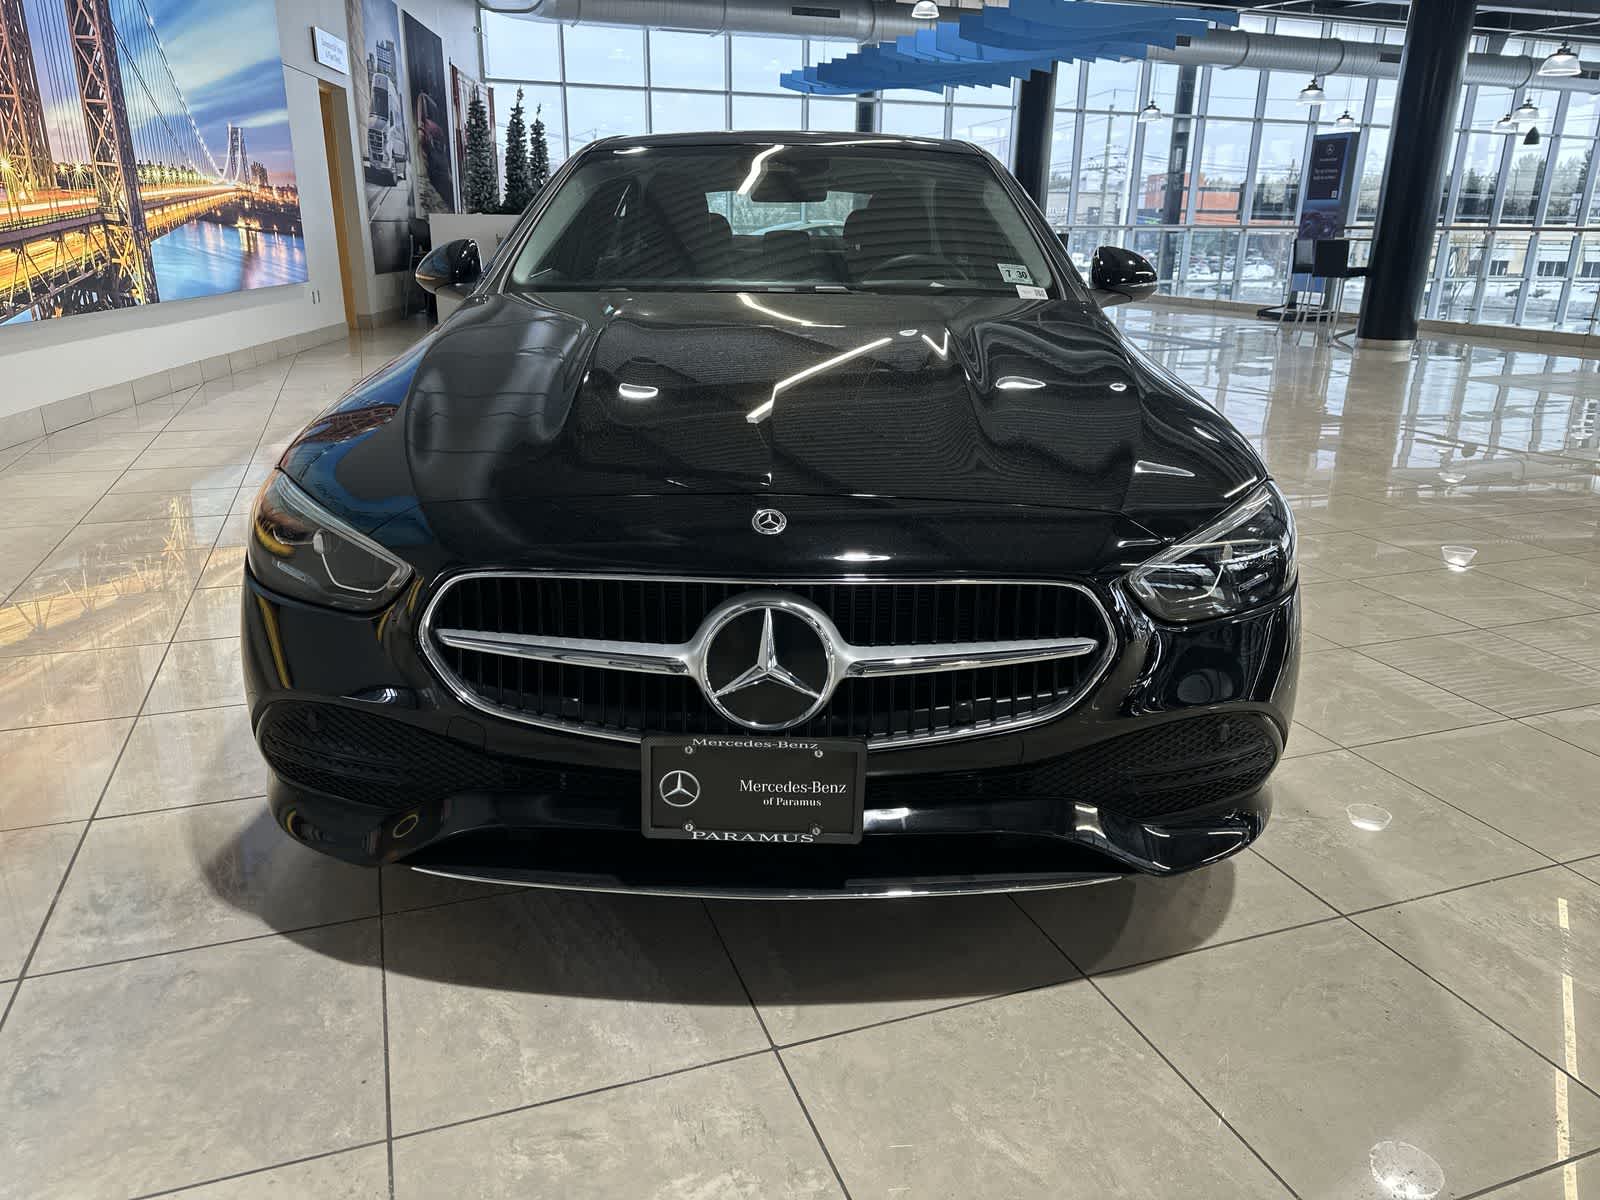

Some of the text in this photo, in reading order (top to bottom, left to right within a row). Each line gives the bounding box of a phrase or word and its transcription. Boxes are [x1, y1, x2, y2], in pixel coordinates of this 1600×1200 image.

[692, 738, 819, 749] Mercedes-Benz
[739, 779, 847, 793] Mercedes-Benz
[763, 797, 822, 806] of Paramus
[691, 831, 814, 843] PARAMUS
